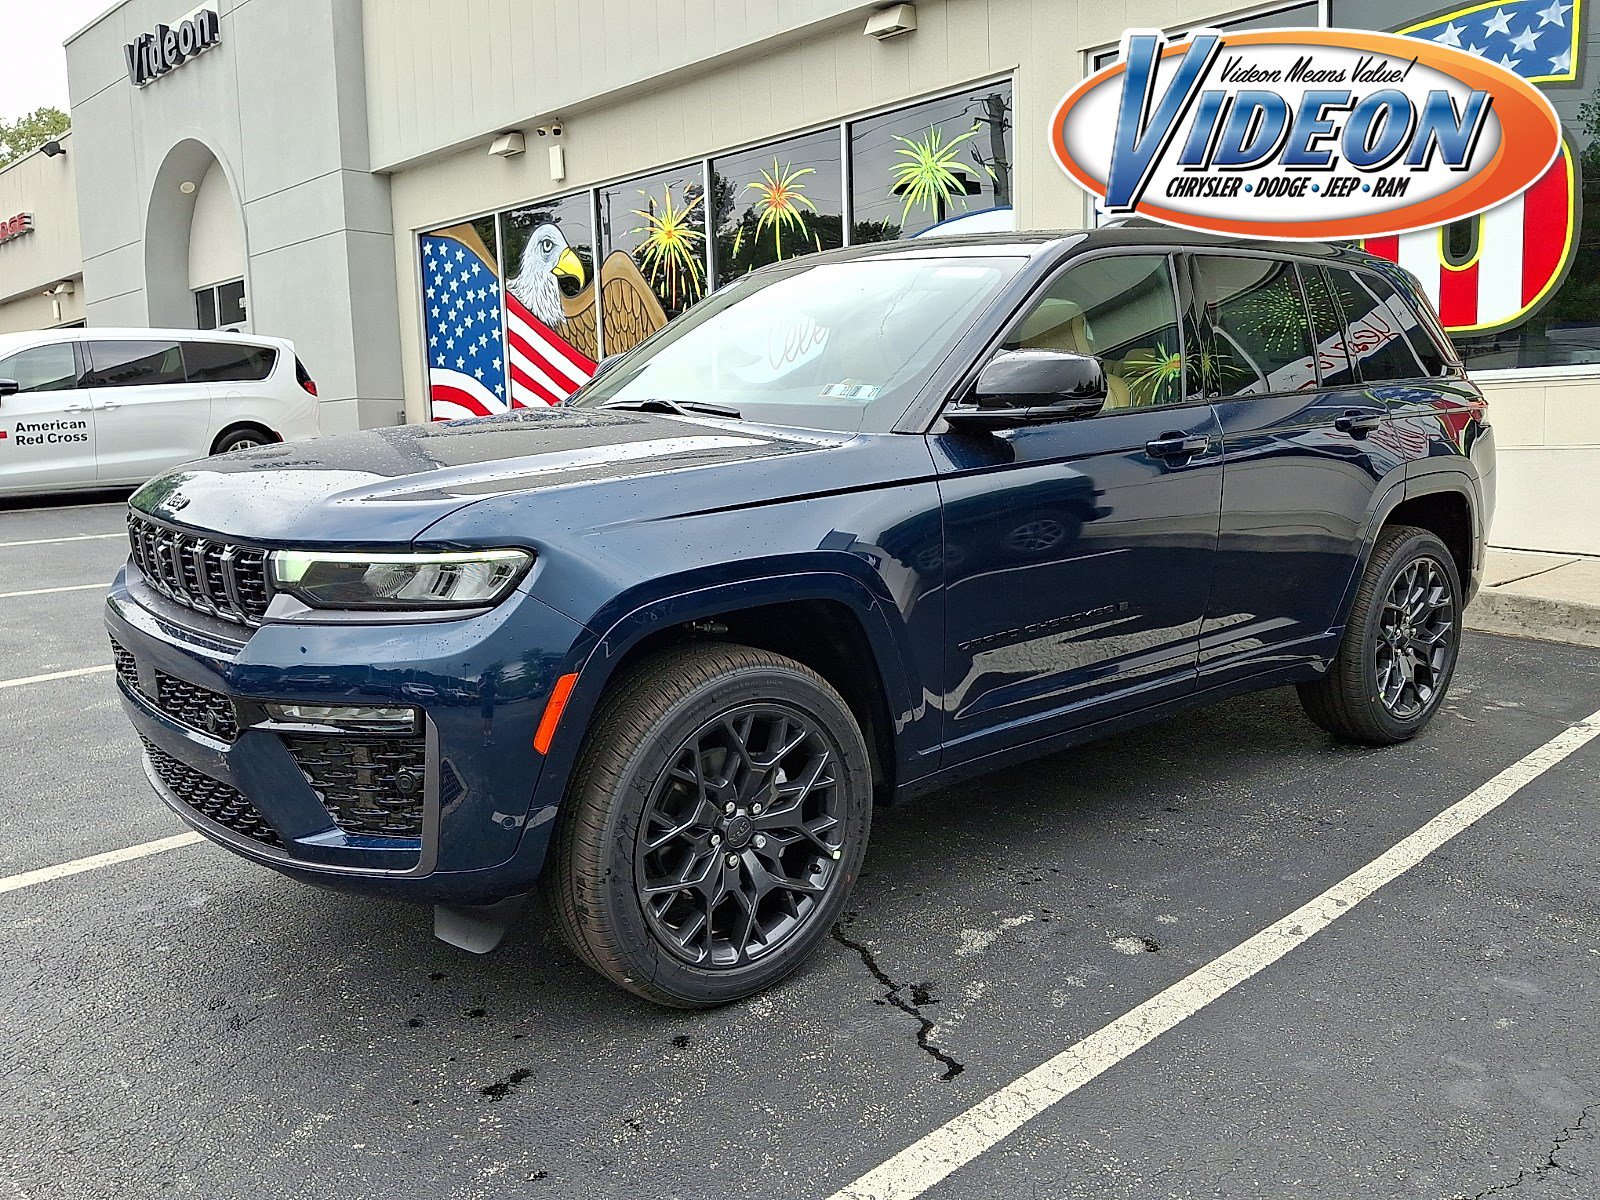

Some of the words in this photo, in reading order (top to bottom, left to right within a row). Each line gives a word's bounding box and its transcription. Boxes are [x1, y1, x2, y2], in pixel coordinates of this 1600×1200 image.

[123, 9, 219, 86] Videon
[16, 420, 86, 432] American
[16, 434, 43, 445] Red
[47, 433, 87, 443] Cross
